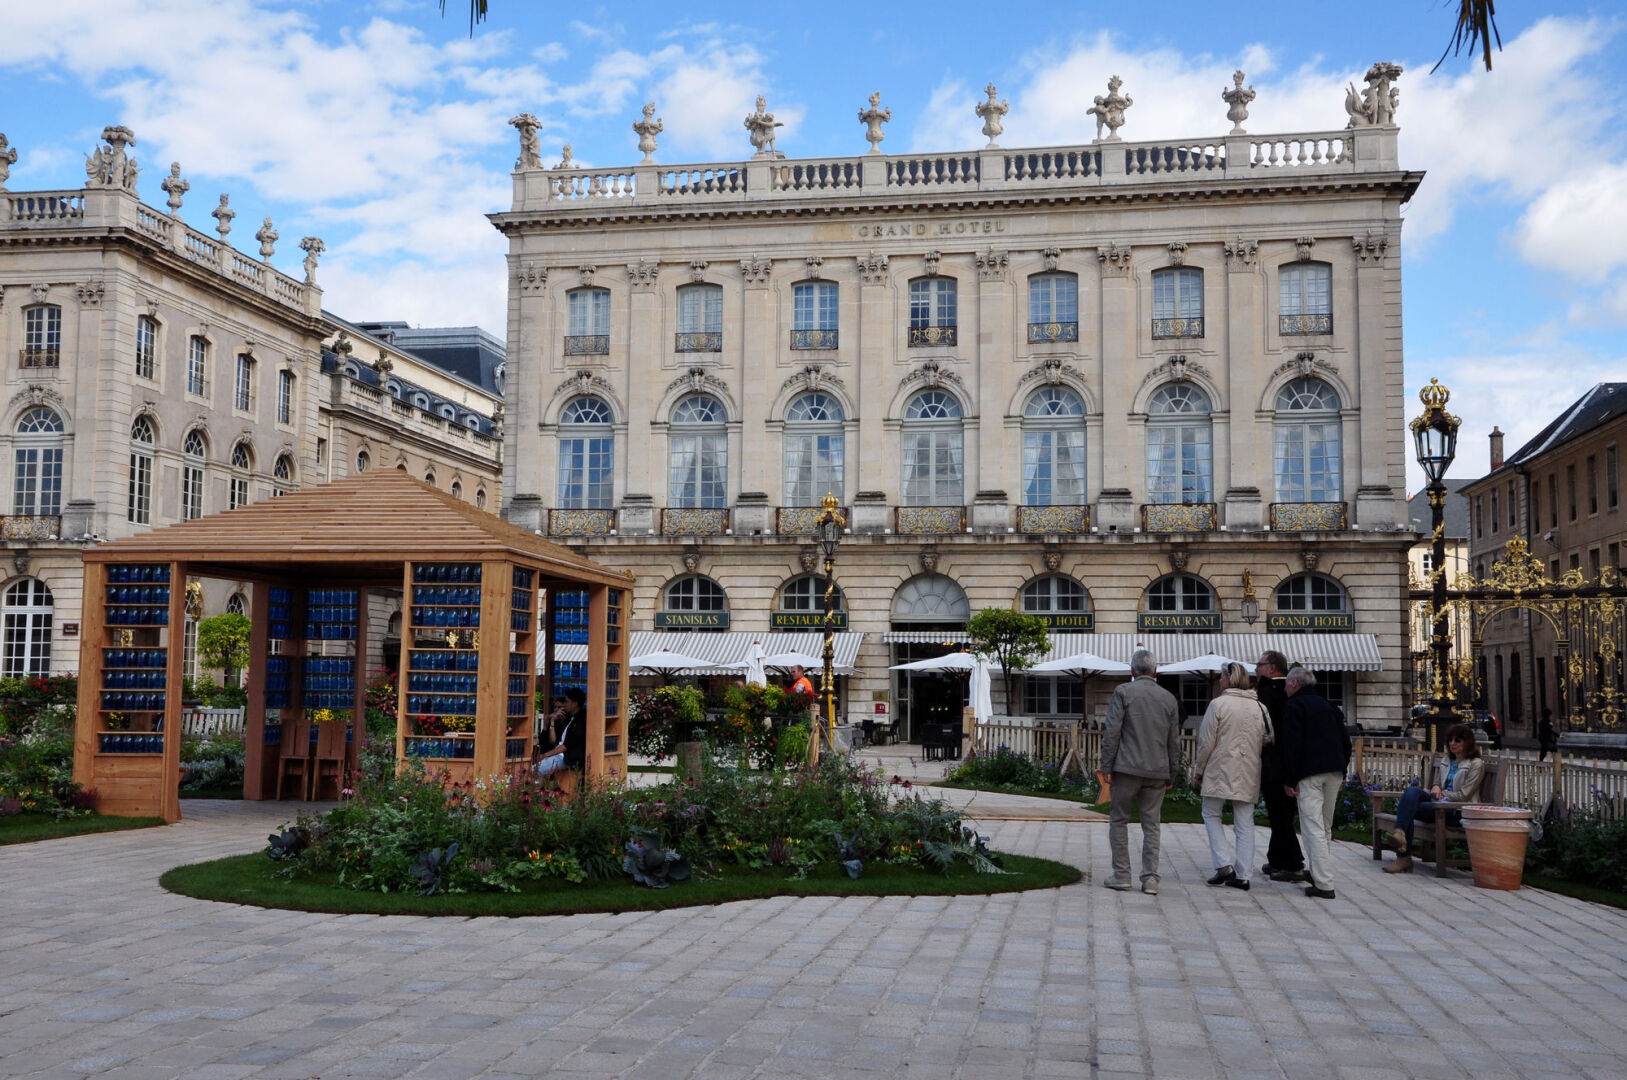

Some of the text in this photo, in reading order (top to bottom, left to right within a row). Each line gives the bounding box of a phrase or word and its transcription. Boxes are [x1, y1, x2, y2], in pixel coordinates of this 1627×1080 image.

[859, 221, 1005, 237] GRAND HOTEL
[665, 615, 719, 625] STANISLAS
[1056, 616, 1090, 626] HOTEL
[1144, 616, 1215, 626] RESTAURANT
[1271, 616, 1351, 627] GRAND HOTEL
